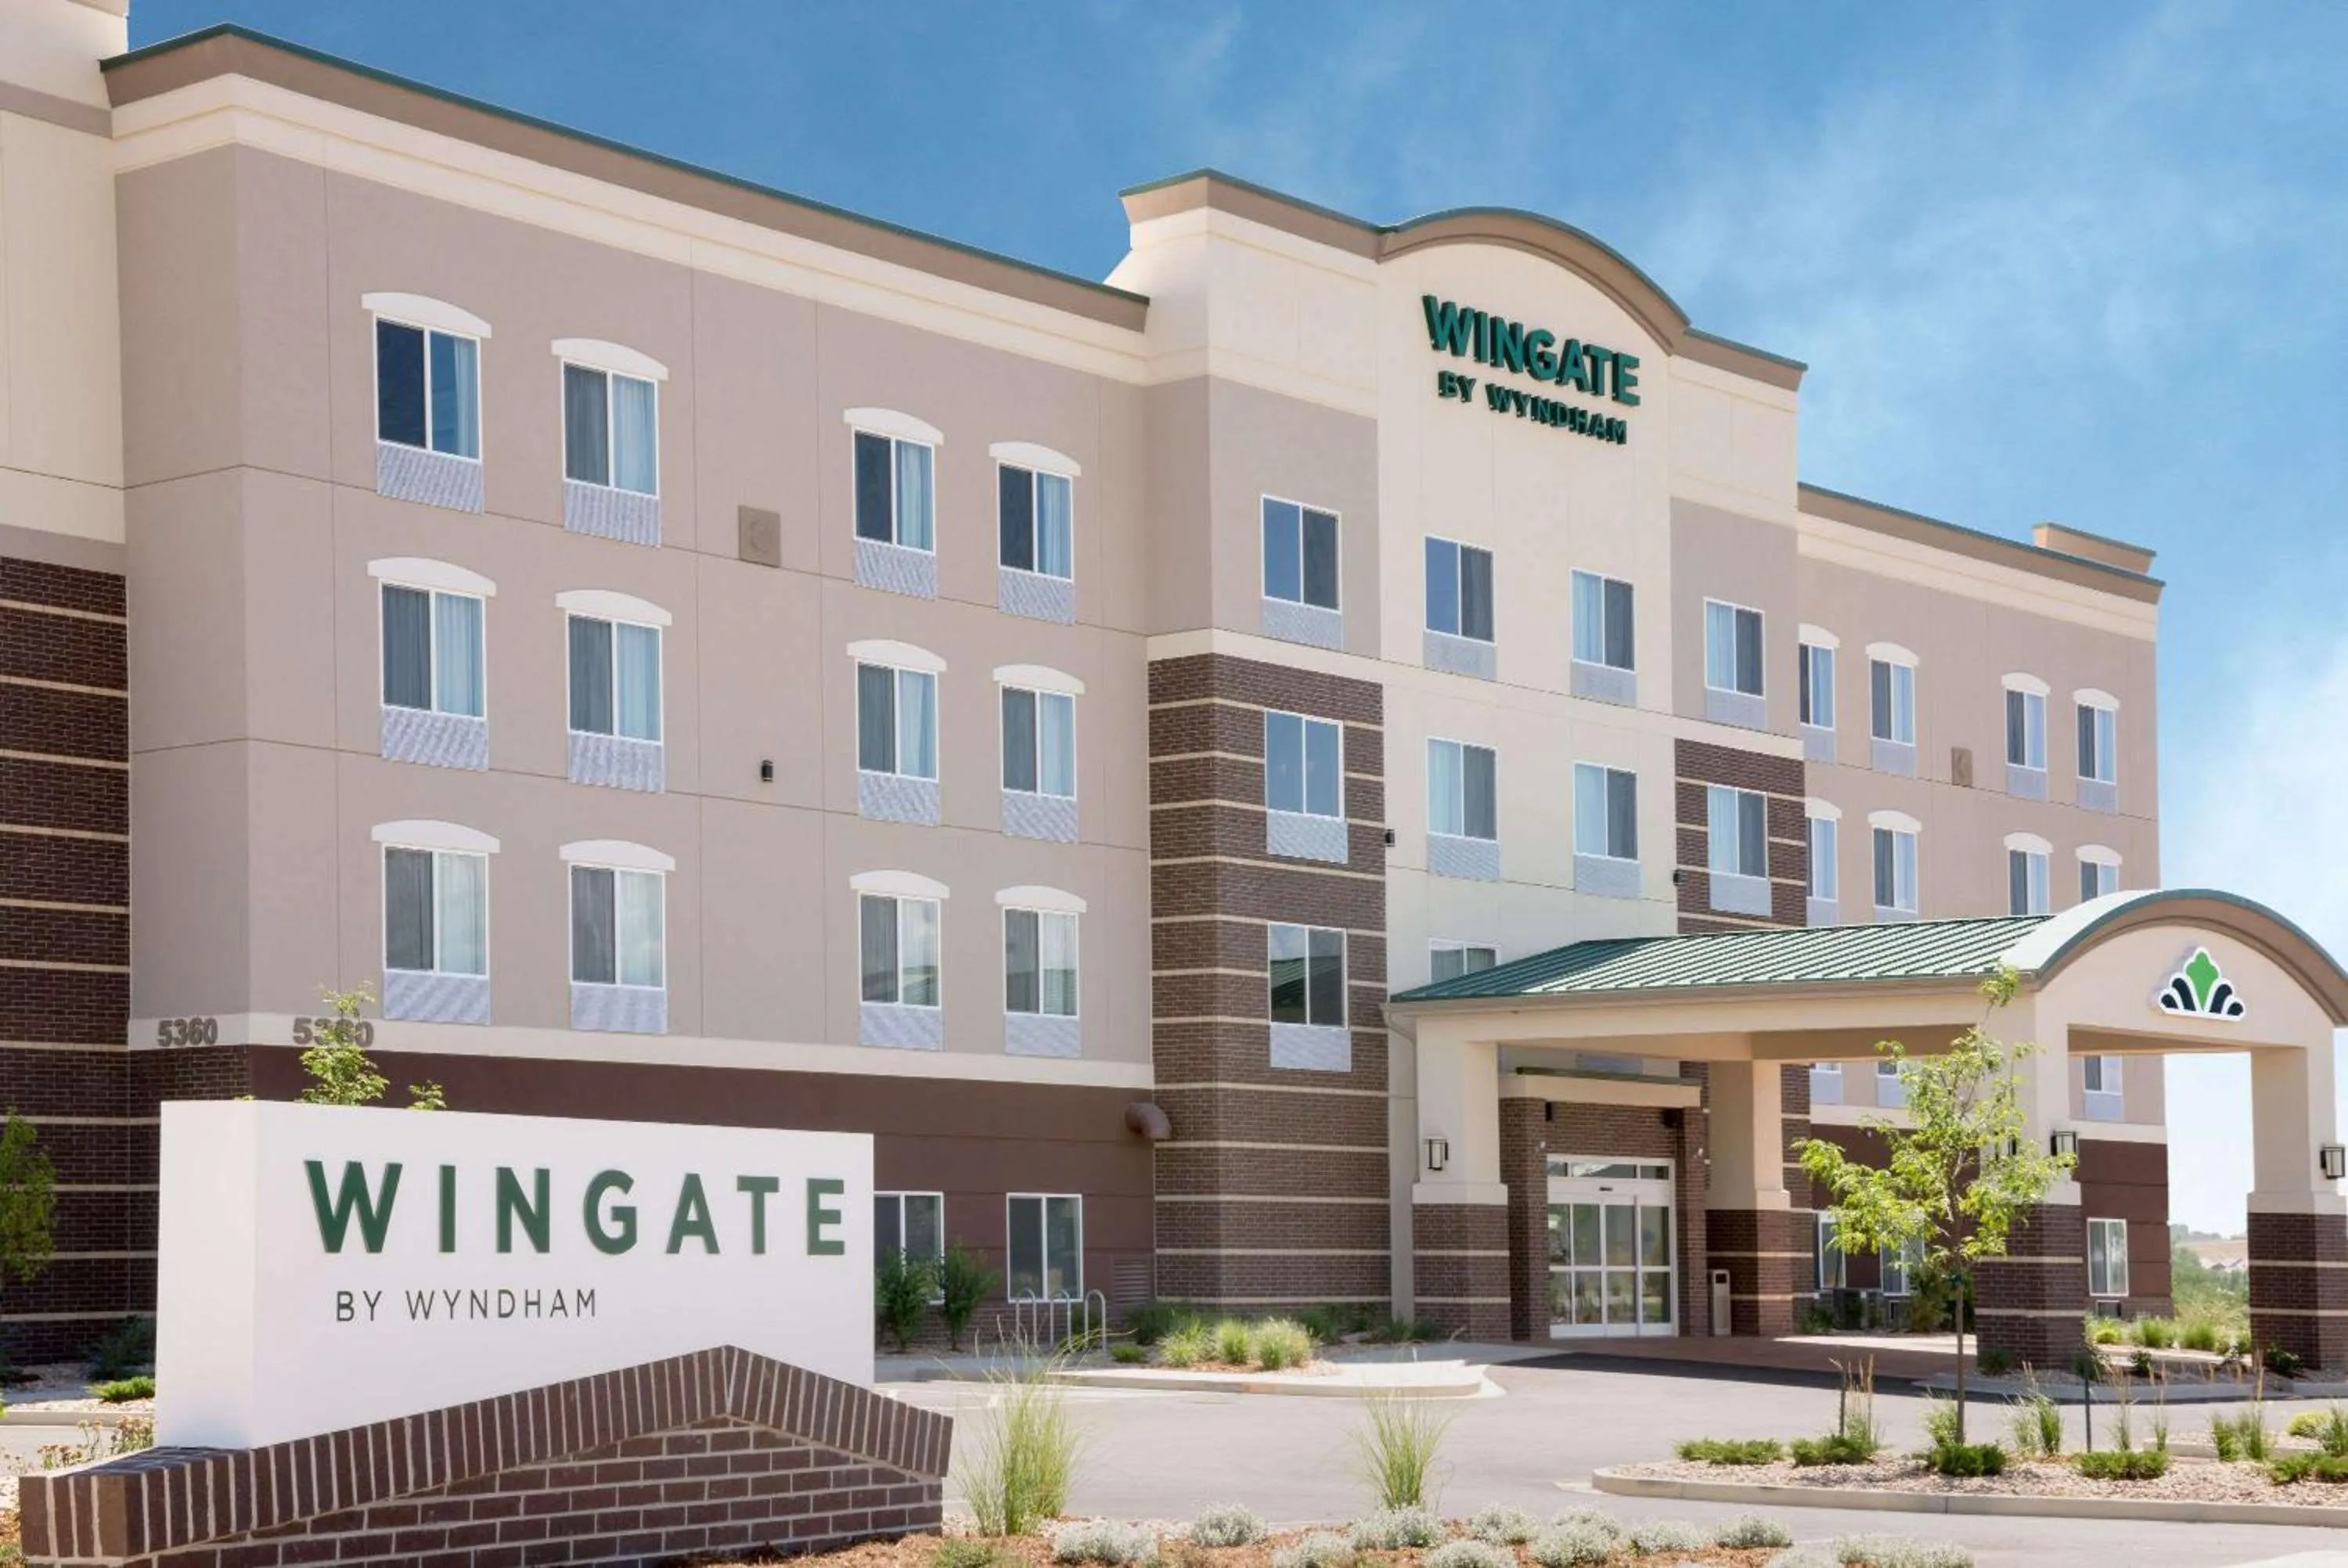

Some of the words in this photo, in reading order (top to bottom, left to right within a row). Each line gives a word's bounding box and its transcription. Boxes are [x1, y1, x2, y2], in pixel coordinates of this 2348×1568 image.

[1422, 294, 1640, 406] WINGATE
[1438, 370, 1477, 402] BY
[1485, 383, 1626, 444] WYNDHAM
[157, 1017, 218, 1047] 5360
[304, 1160, 846, 1256] WINGATE
[336, 1290, 382, 1322] BY
[405, 1289, 598, 1321] WYNDHAM
